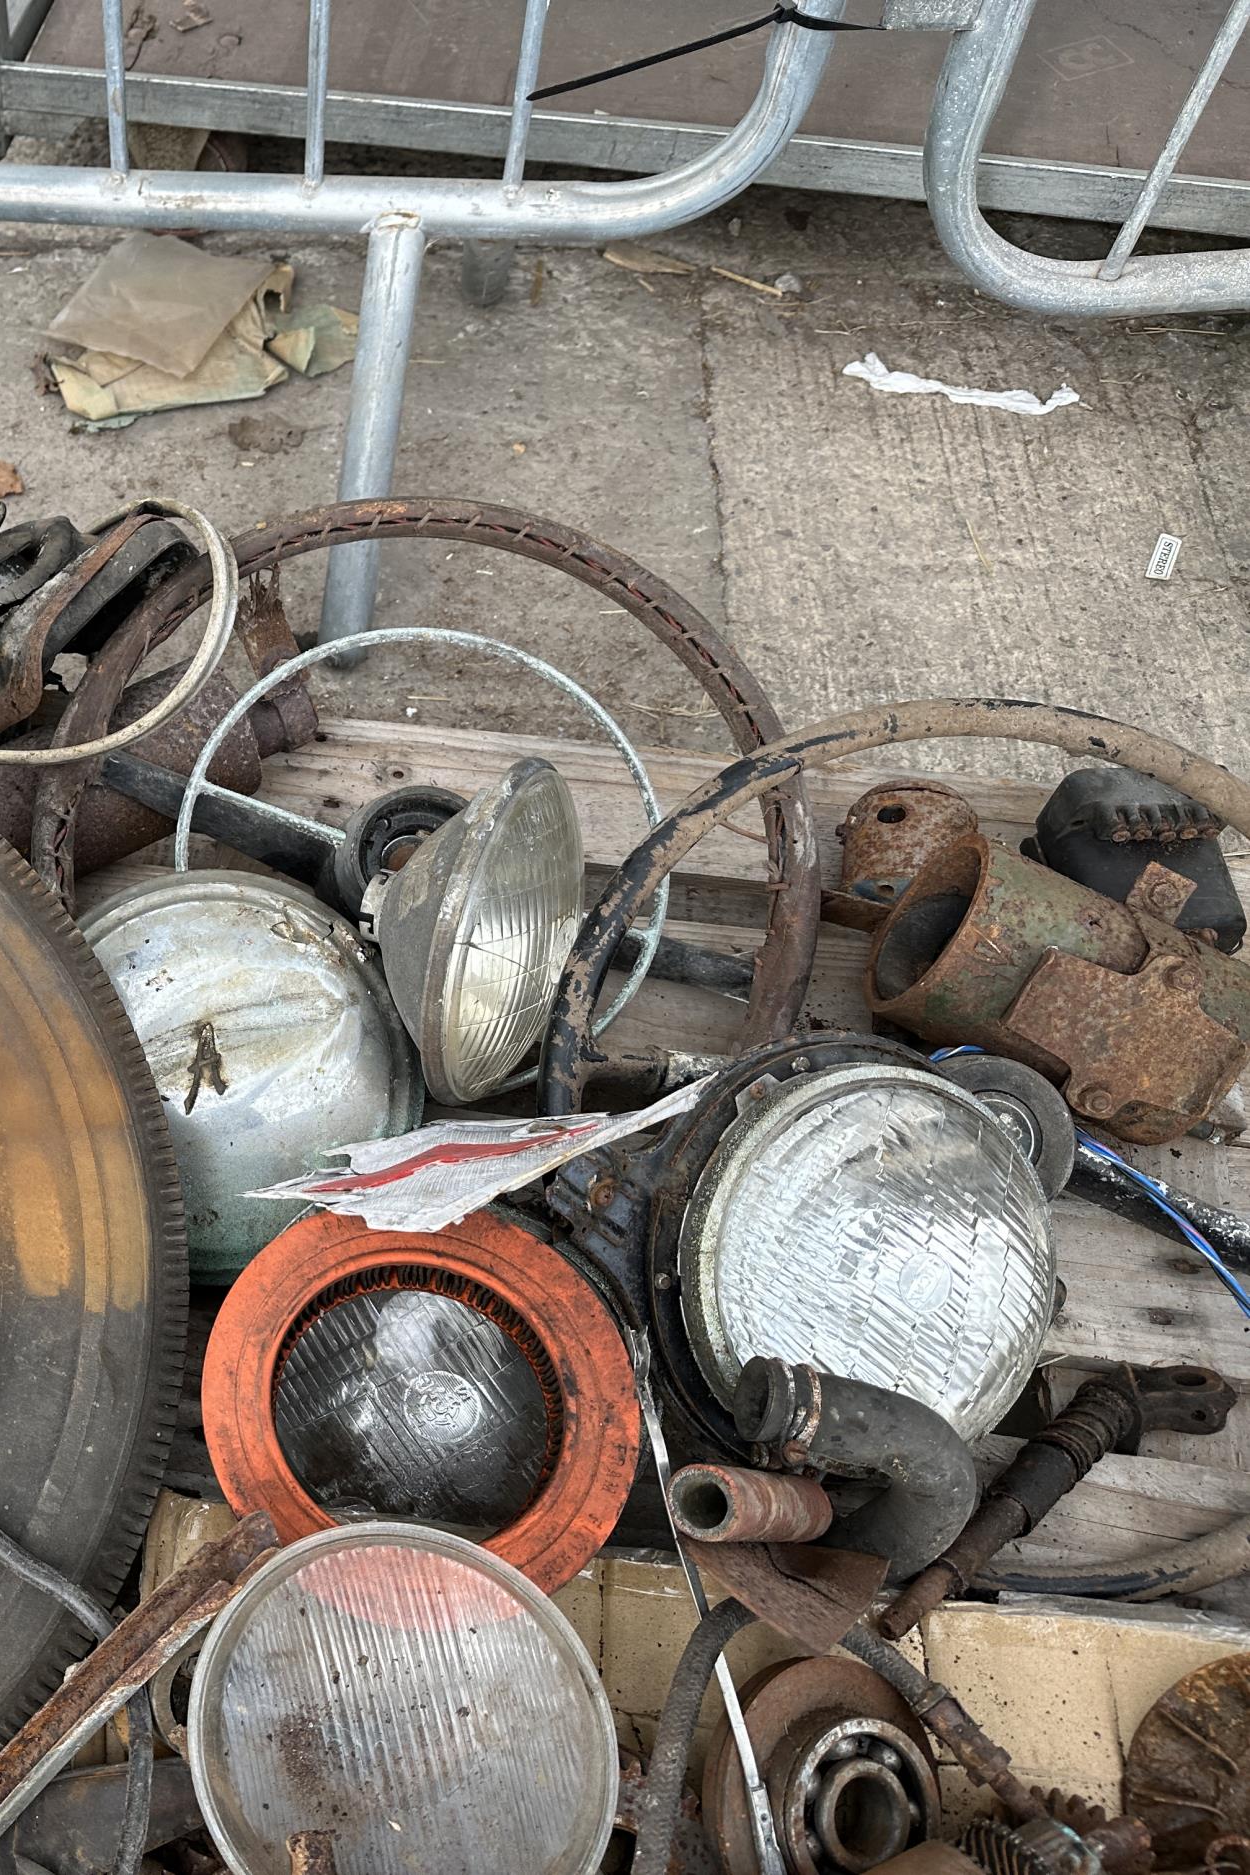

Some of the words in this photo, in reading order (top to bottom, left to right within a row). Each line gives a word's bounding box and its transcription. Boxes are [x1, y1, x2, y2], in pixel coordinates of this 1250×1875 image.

[1153, 541, 1174, 575] STEREO
[409, 1384, 472, 1428] LUCAS
[600, 1441, 628, 1495] FRAM
